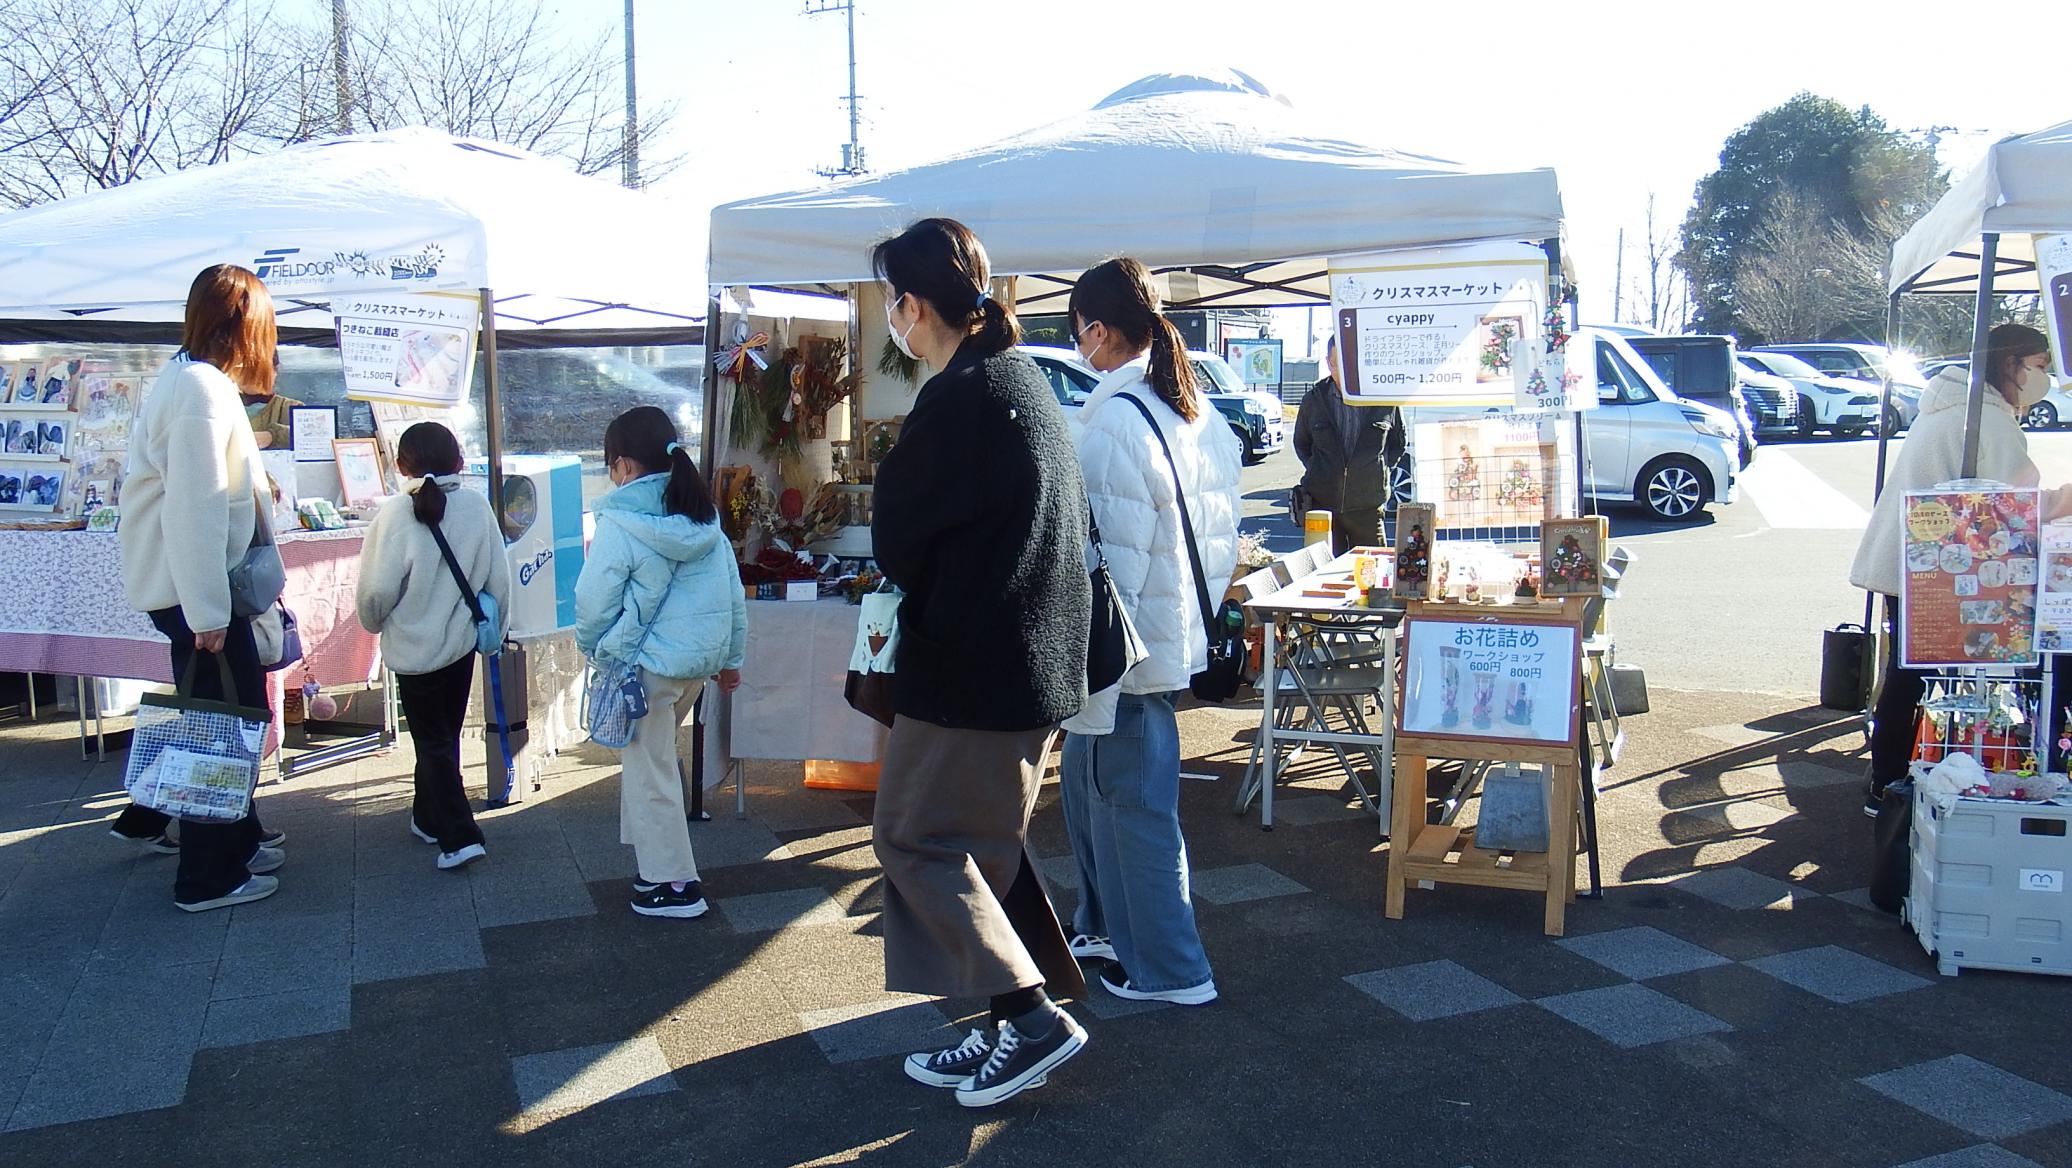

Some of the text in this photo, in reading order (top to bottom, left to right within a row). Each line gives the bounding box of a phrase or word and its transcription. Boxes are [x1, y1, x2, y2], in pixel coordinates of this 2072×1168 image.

[271, 261, 335, 278] FIELDOOR
[1372, 281, 1503, 300] クリスマスマーケット
[2058, 283, 2069, 297] 2
[354, 302, 445, 319] クリスマスマーケット
[1344, 317, 1352, 328] 3
[1387, 312, 1435, 325] cyappy
[1364, 340, 1465, 351] クリスマスリース、正月リー
[362, 370, 393, 382] 1,500円
[1912, 572, 1937, 580] MENU
[1454, 626, 1540, 648] お花詰め
[1463, 650, 1545, 663] ワークショップ
[1469, 661, 1501, 672] 600円
[1510, 667, 1542, 679] 800円
